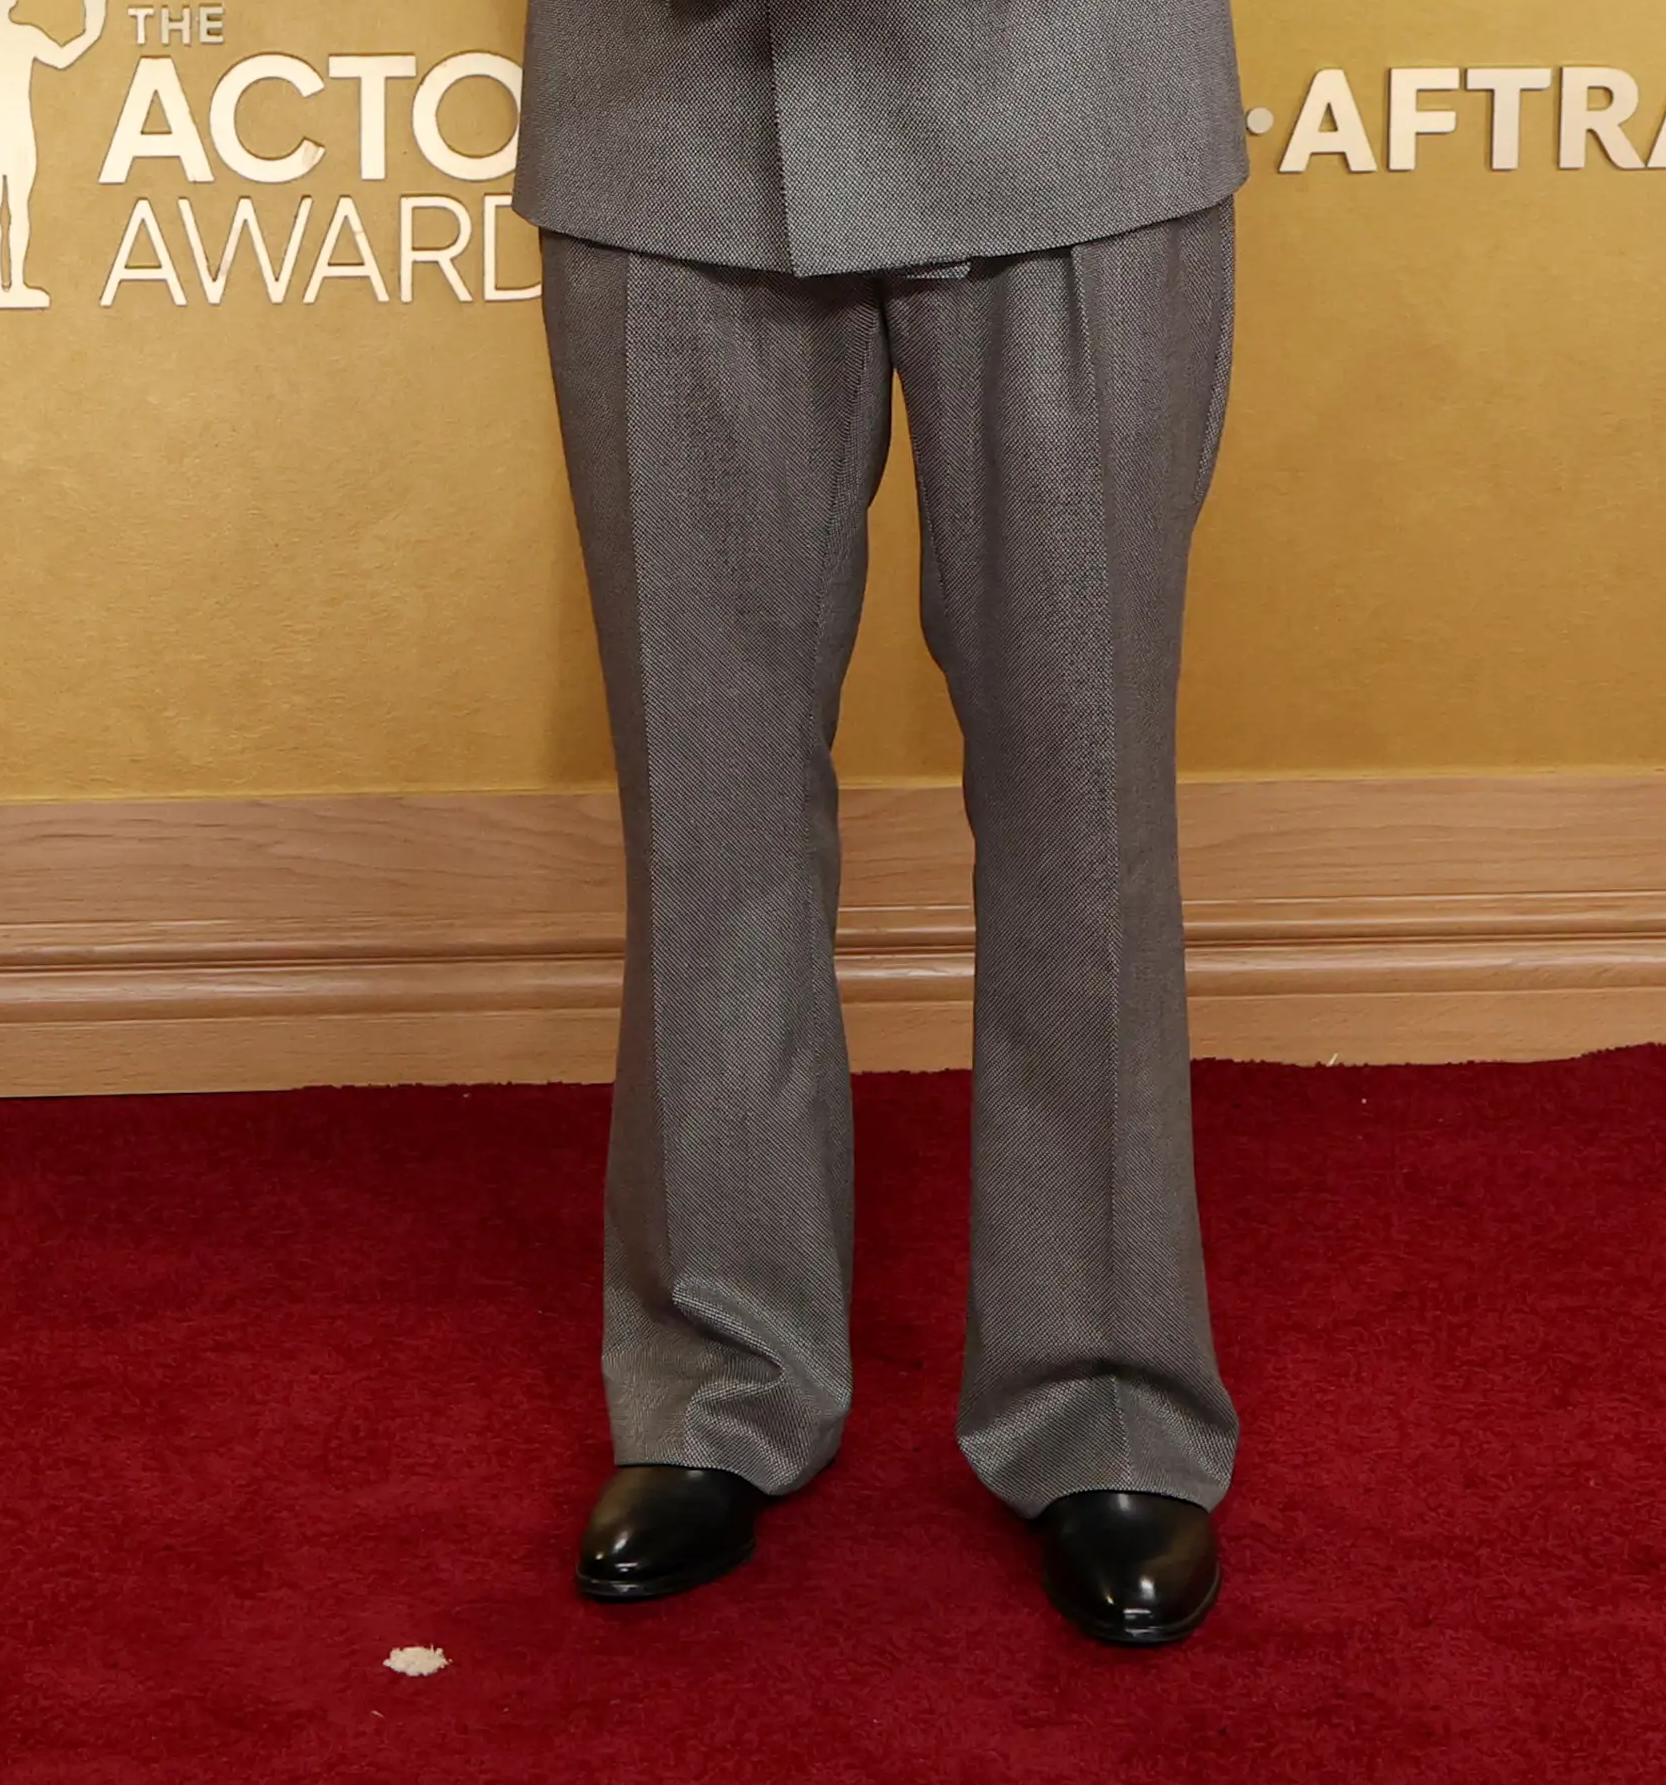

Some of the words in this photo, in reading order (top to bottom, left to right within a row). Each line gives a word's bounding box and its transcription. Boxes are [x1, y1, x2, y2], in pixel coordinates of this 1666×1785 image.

[128, 3, 225, 46] THE
[98, 51, 523, 185] ACTO
[99, 193, 542, 308] AWARD
